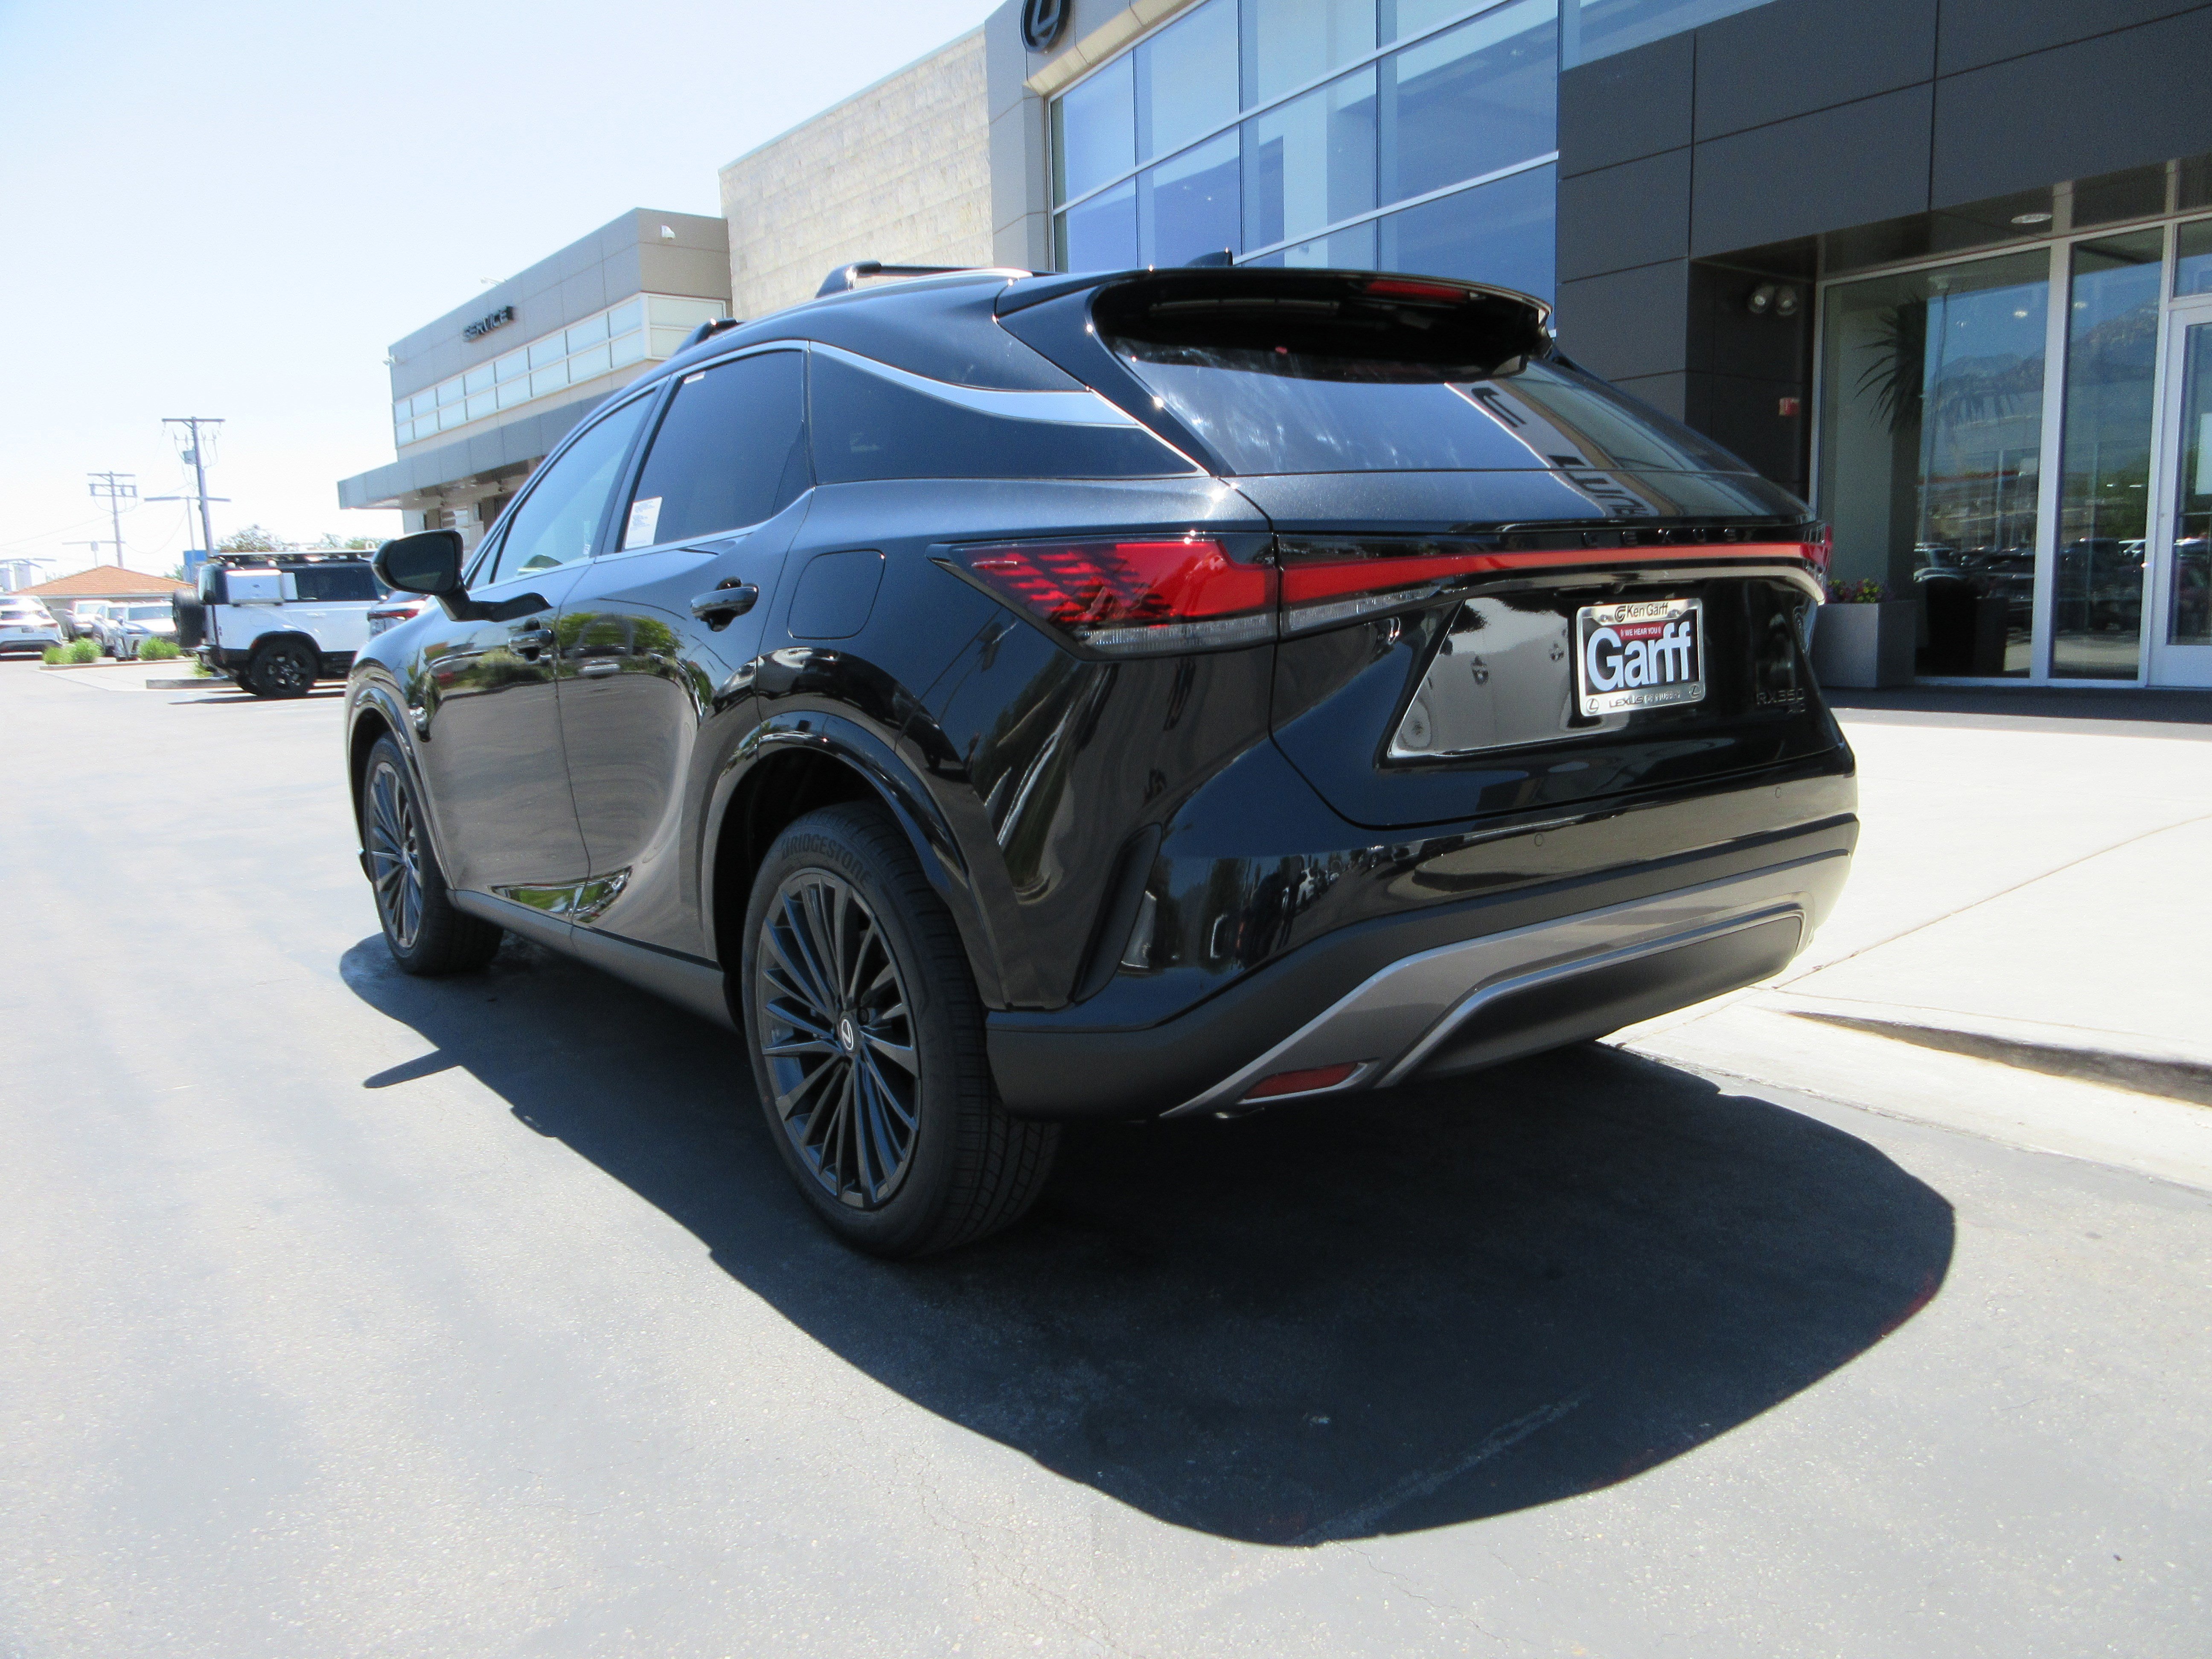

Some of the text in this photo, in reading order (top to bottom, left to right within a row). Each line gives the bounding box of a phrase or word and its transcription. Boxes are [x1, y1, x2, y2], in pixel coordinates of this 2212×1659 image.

[463, 306, 514, 341] SERVICE
[1626, 601, 1669, 618] Ken Garff
[1633, 628, 1647, 636] HEAR
[1647, 626, 1658, 634] YOU
[1587, 621, 1691, 691] Garff
[1609, 696, 1644, 708] LEXUS
